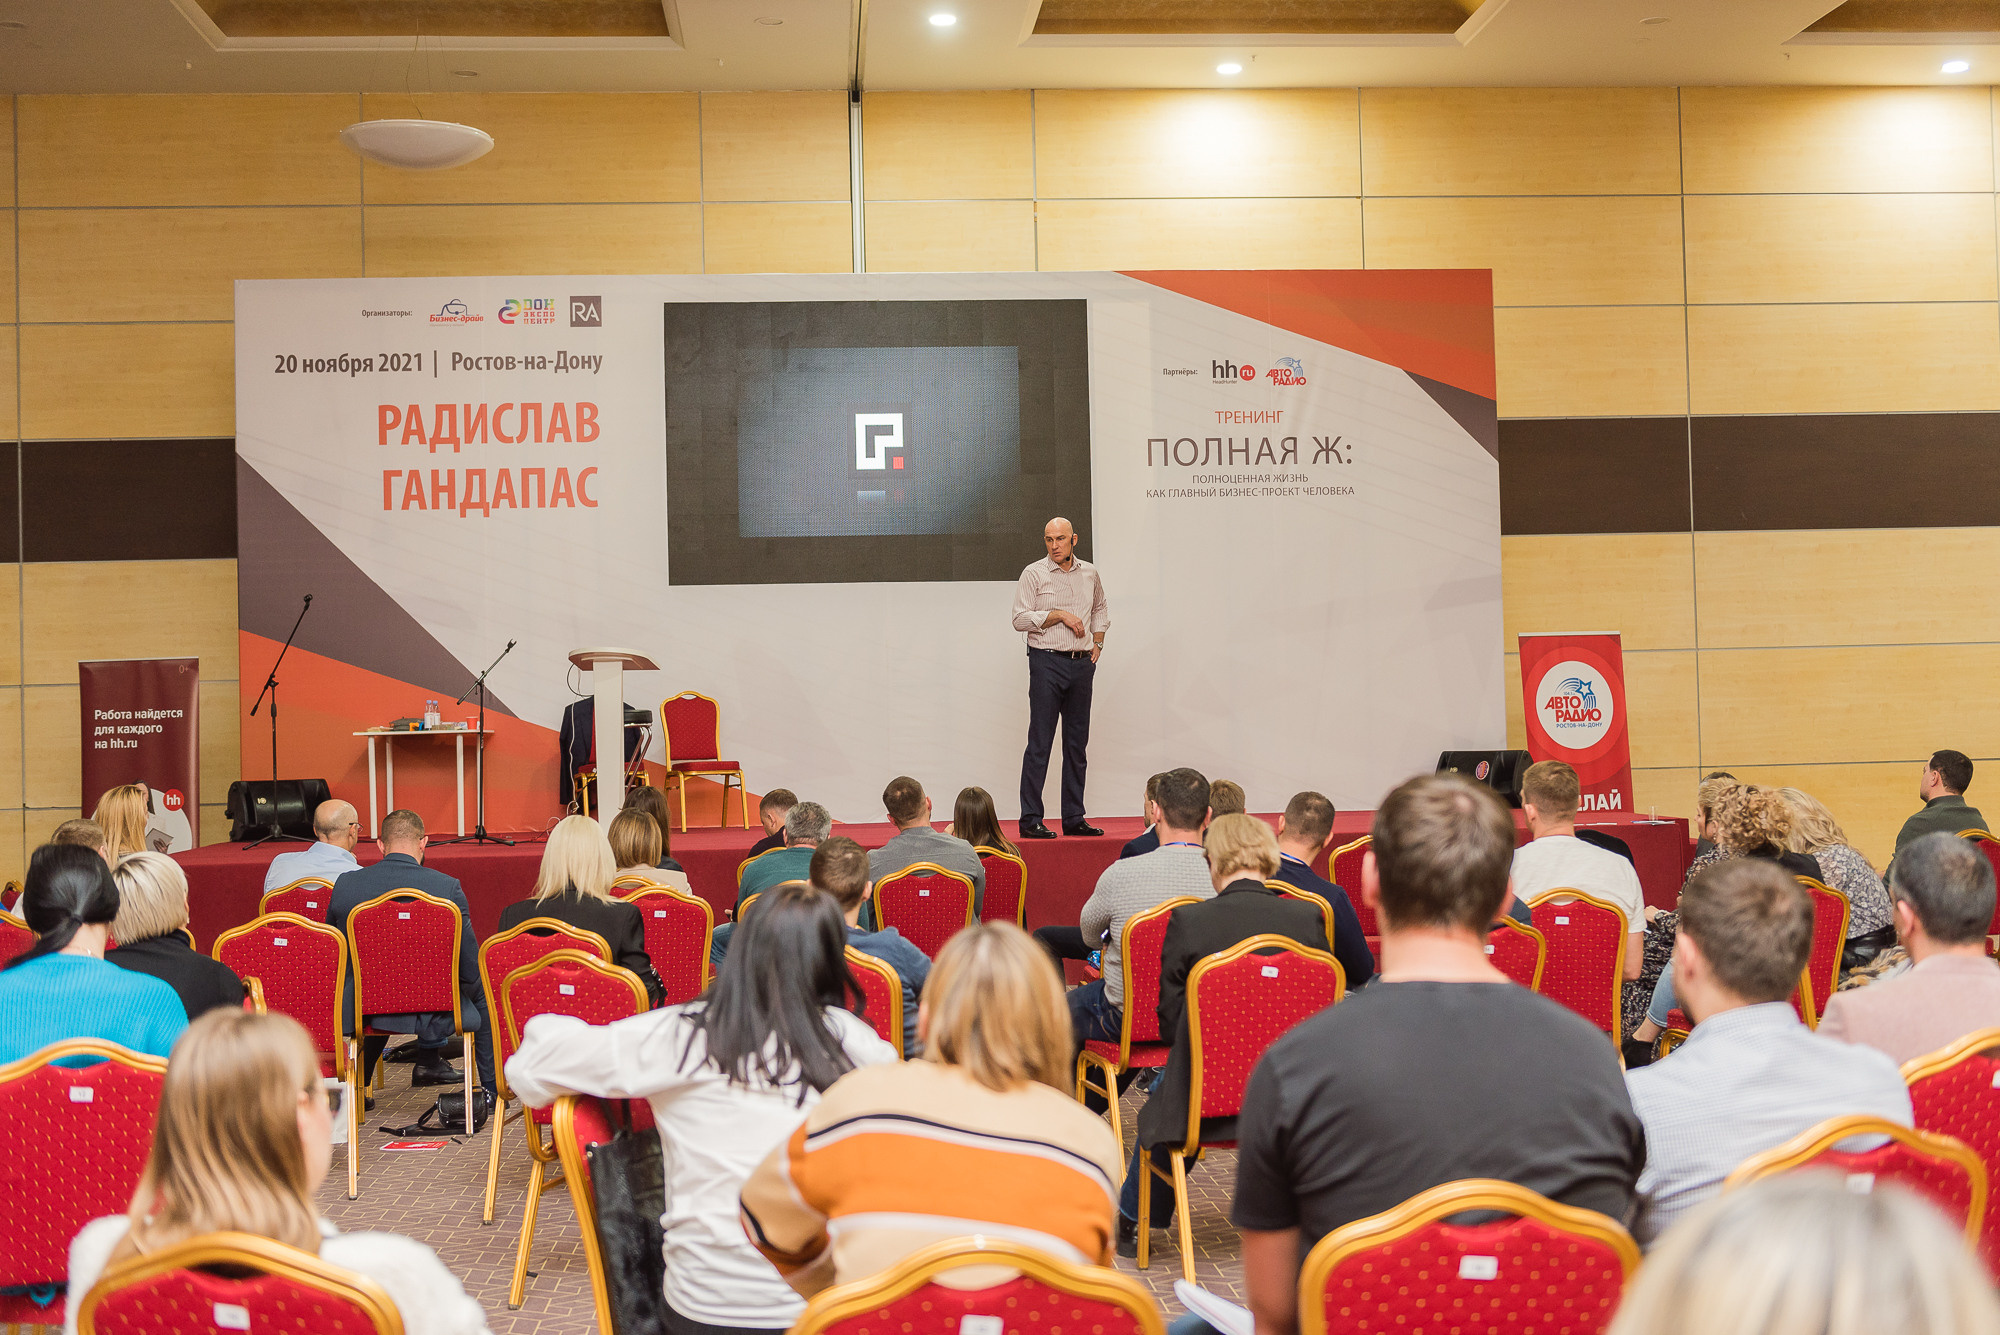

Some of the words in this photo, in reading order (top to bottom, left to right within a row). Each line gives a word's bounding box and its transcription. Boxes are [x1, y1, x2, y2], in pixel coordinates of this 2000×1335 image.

[523, 299, 555, 310] ДОН
[361, 308, 413, 318] Организаторы:
[572, 302, 600, 322] RA
[274, 354, 298, 373] 20
[302, 353, 374, 377] ноября
[378, 353, 422, 372] 2021
[451, 350, 603, 375] Ростов-на-Дону
[1265, 368, 1292, 378] АВТО
[1273, 376, 1307, 386] РАДИО
[1215, 410, 1284, 424] ТРЕНИНГ
[378, 402, 600, 453] РАДИСЛАВ
[1147, 437, 1298, 466] ПОЛНАЯ
[1312, 436, 1352, 465] Ж:
[1192, 475, 1271, 485] ПОЛНОЦЕННАЯ
[1273, 474, 1309, 483] ЖИЗНЬ
[383, 466, 599, 518] ГАНДАПАС
[1146, 489, 1166, 498] КАК
[1168, 487, 1217, 498] ГЛАВНЫЙ
[1219, 487, 1300, 497] БИЗНЕС-ПРОЕКТ
[1302, 486, 1355, 496] ЧЕЛОВЕКА
[1545, 696, 1581, 710] АВТО
[94, 710, 132, 720] Работа
[134, 708, 183, 719] найдется
[1555, 709, 1602, 722] РАДИО
[94, 726, 114, 736] для
[117, 723, 163, 735] каждого
[94, 740, 108, 749] на
[110, 739, 138, 749] hh.ru
[166, 795, 181, 806] hh
